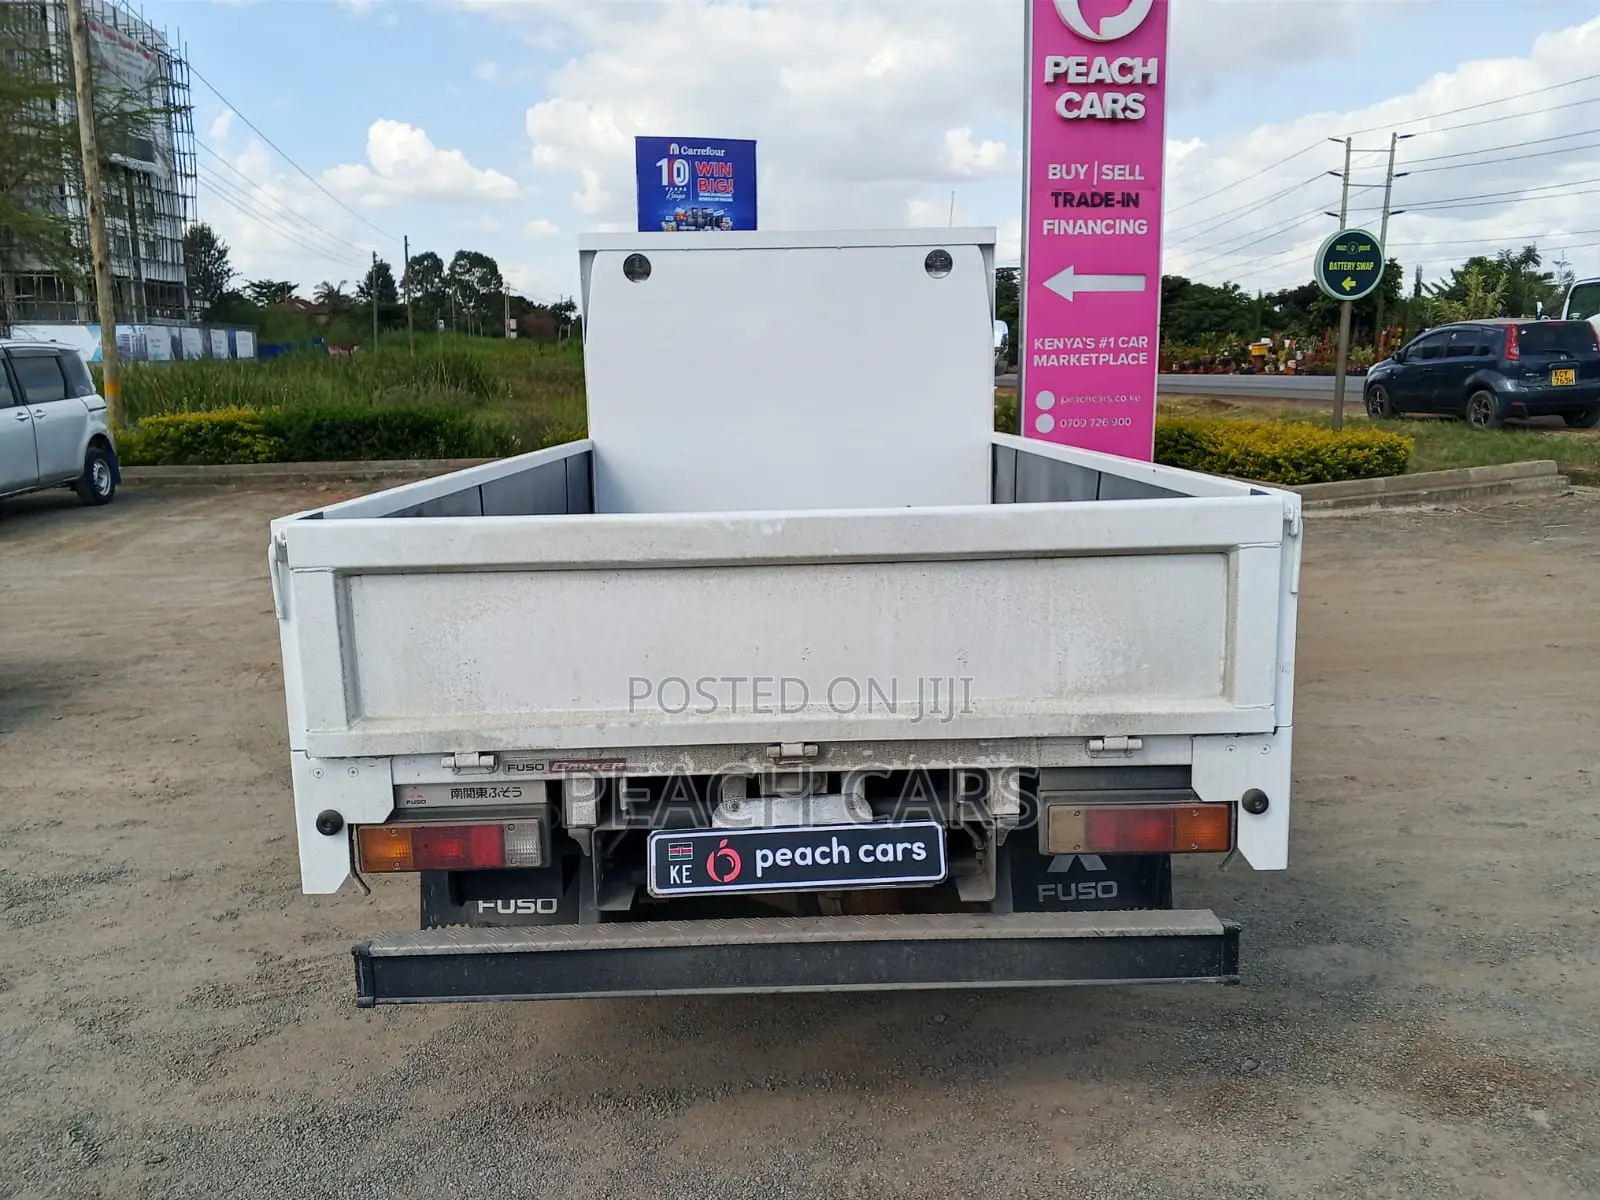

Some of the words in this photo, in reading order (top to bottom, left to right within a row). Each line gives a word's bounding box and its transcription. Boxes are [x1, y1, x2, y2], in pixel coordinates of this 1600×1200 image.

[1044, 55, 1158, 85] PEACH
[1055, 91, 1146, 120] CARS
[680, 145, 725, 157] Carrefour
[656, 157, 689, 186] 10
[695, 160, 733, 178] WIN
[1048, 163, 1089, 180] BUY
[1101, 164, 1145, 181] SELL
[697, 177, 734, 194] BIG!
[1050, 191, 1140, 208] TRADE-IN
[1042, 218, 1148, 236] FINANCING
[1329, 261, 1355, 271] BATTERY
[1356, 261, 1375, 271] SWAP
[1033, 336, 1096, 350] KENYA'S
[1099, 336, 1115, 349] #1
[1118, 335, 1149, 348] CAR
[1033, 352, 1149, 367] MARKETPLACE
[507, 762, 545, 772] FUSO
[450, 786, 523, 800] 南関東ふそう
[755, 837, 850, 877] peach
[858, 839, 927, 863] cars
[669, 864, 693, 884] KE
[1037, 880, 1118, 902] FUSO
[477, 898, 557, 914] FUSO
